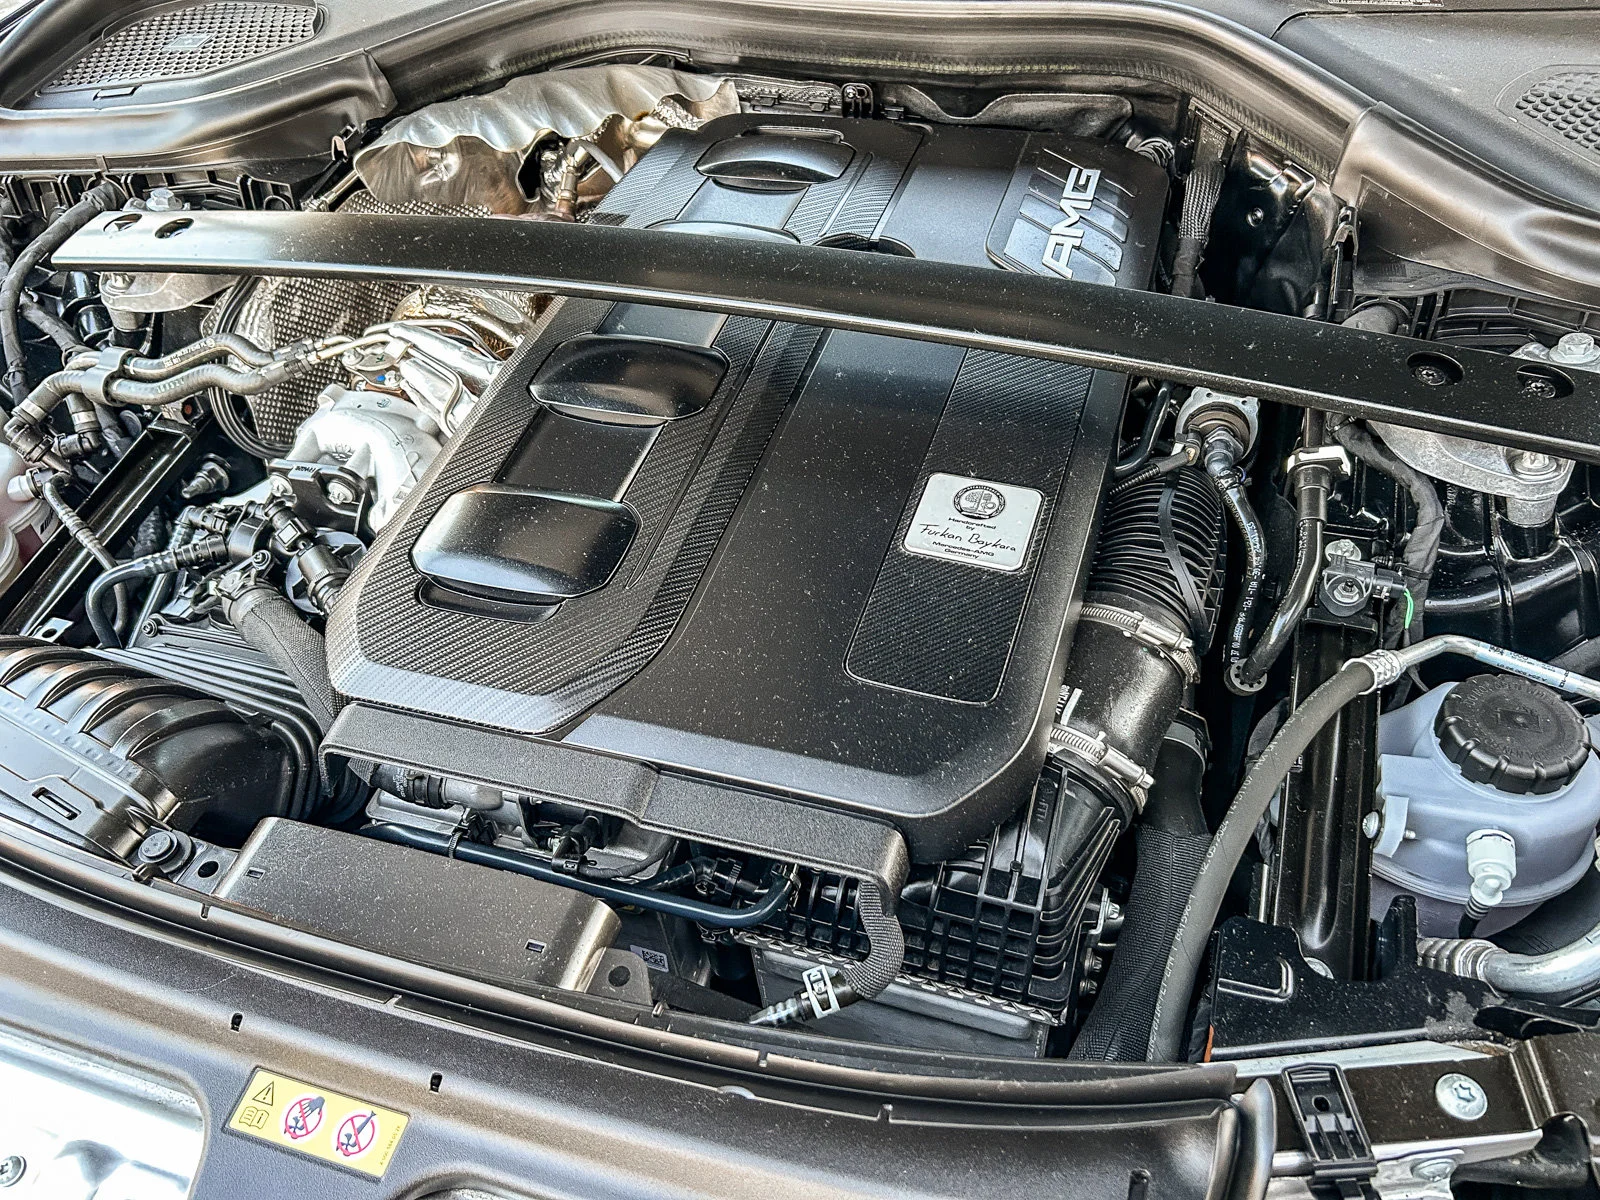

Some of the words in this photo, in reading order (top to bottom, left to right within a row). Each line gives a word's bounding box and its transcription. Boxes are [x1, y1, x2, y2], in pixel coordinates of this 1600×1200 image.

[1041, 167, 1101, 280] AMG
[948, 517, 997, 530] Handcrafted
[919, 523, 963, 541] Furkan
[967, 532, 1017, 553] Baykara
[932, 541, 995, 557] Mercedes-AMG
[944, 548, 980, 560] Germany
